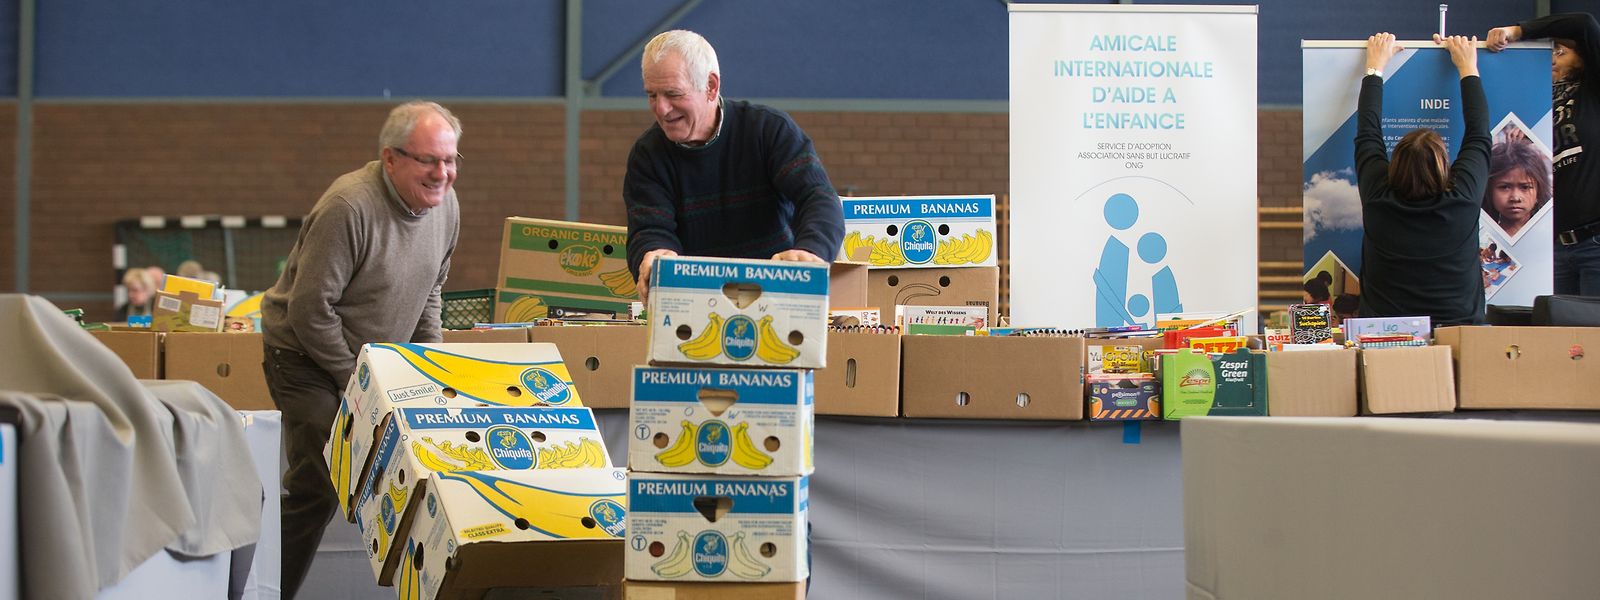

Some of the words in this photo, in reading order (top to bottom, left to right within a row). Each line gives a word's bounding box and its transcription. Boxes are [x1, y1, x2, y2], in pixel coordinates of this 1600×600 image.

[1090, 35, 1177, 51] AMICALE
[1054, 60, 1213, 78] INTERNATIONALE
[1092, 87, 1156, 103] D'AIDE
[1162, 87, 1177, 103] A
[1420, 99, 1450, 110] INDE
[1083, 112, 1185, 129] L'ENFANCE
[1078, 152, 1125, 160] ASSOCIATION
[1126, 152, 1145, 160] SANS
[1146, 152, 1158, 160] BUT
[1160, 152, 1191, 160] LUCRATIF
[1125, 161, 1144, 169] ONG
[853, 204, 911, 215] PREMIUM
[921, 202, 979, 214] BANANAS
[522, 226, 580, 241] ORGANIC
[583, 231, 628, 245] BANAN
[904, 240, 933, 252] Chiquita
[673, 263, 738, 279] PREMIUM
[745, 267, 811, 283] BANANAS
[663, 315, 672, 327] A
[725, 336, 754, 349] Chiquita
[1220, 360, 1249, 370] Zespri
[642, 371, 711, 385] PREMIUM
[719, 373, 792, 388] BANANAS
[1221, 369, 1248, 378] Green
[1179, 375, 1211, 387] Zespri
[392, 390, 410, 400] Just
[410, 385, 436, 397] Smile!
[537, 382, 568, 402] Chiquita
[415, 413, 492, 425] PREMIUM
[503, 413, 580, 425] BANANAS
[493, 447, 533, 462] Chiquita
[698, 442, 729, 454] Chiquita
[637, 482, 707, 496] PREMIUM
[715, 483, 788, 497] BANANAS
[695, 552, 726, 564] Chiquita
